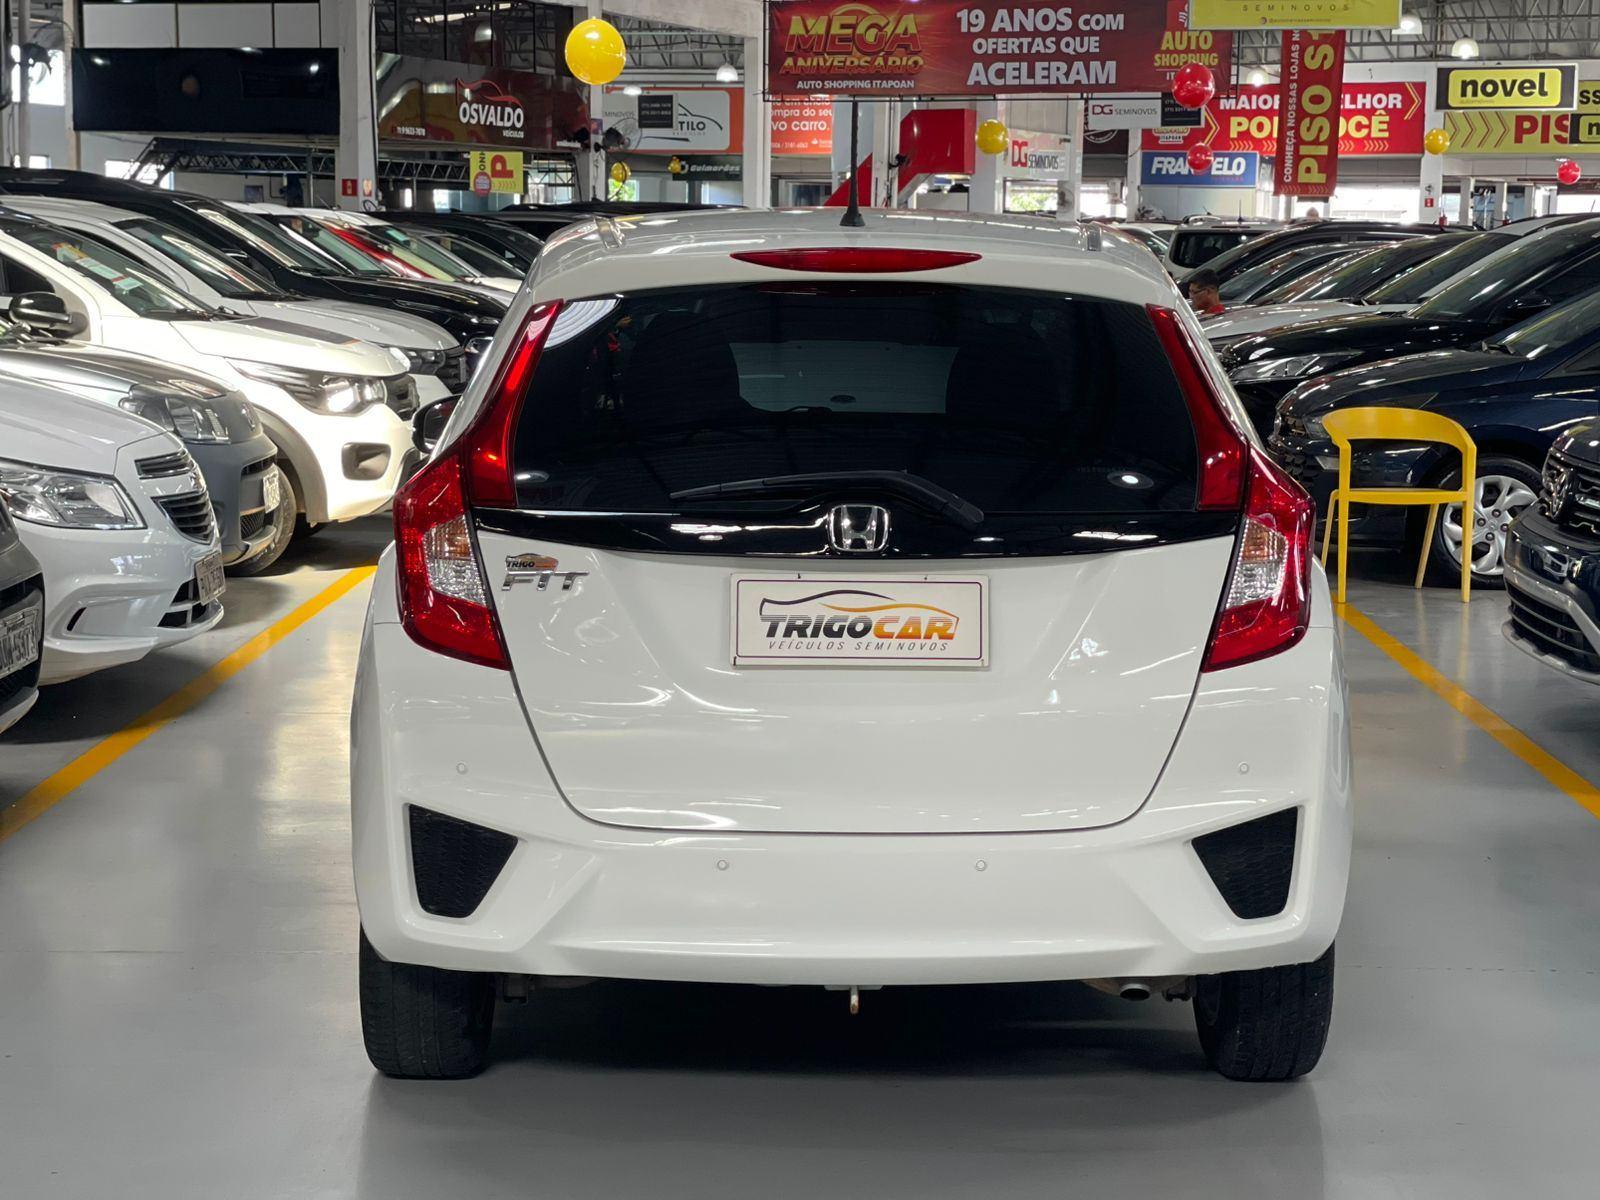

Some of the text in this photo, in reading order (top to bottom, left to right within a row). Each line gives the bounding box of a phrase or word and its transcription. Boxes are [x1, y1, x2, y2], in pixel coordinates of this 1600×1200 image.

[956, 7, 1125, 33] 19 ANOS COM
[1242, 4, 1350, 12] SEMINOVOS
[784, 14, 922, 54] MEGA
[972, 36, 1101, 55] OFERTAS QUE
[1160, 30, 1213, 51] AUTO
[779, 52, 925, 76] ANIVERSÁRIO
[1153, 52, 1219, 67] SHOPPING
[1289, 43, 1300, 80] LOJAS
[797, 79, 915, 89] AUTO SHOPPING ITAPOAN
[966, 60, 1117, 86] ACELERAM
[1460, 71, 1549, 98] novel
[459, 102, 525, 128] OSVALDO
[771, 108, 800, 118] mpra
[802, 107, 816, 117] do
[1092, 104, 1113, 115] DG
[1115, 107, 1157, 116] SEMINOVOS
[1286, 80, 1298, 127] NOSSAS
[678, 120, 706, 132] TILO
[791, 120, 831, 131] carro.
[1297, 84, 1333, 184] PISO
[1011, 140, 1028, 167] DG
[1283, 129, 1295, 183] CONHEÇA
[759, 614, 956, 641] TRIGOCAR
[768, 638, 949, 651] VEÍCULOS SEMINOVOS
